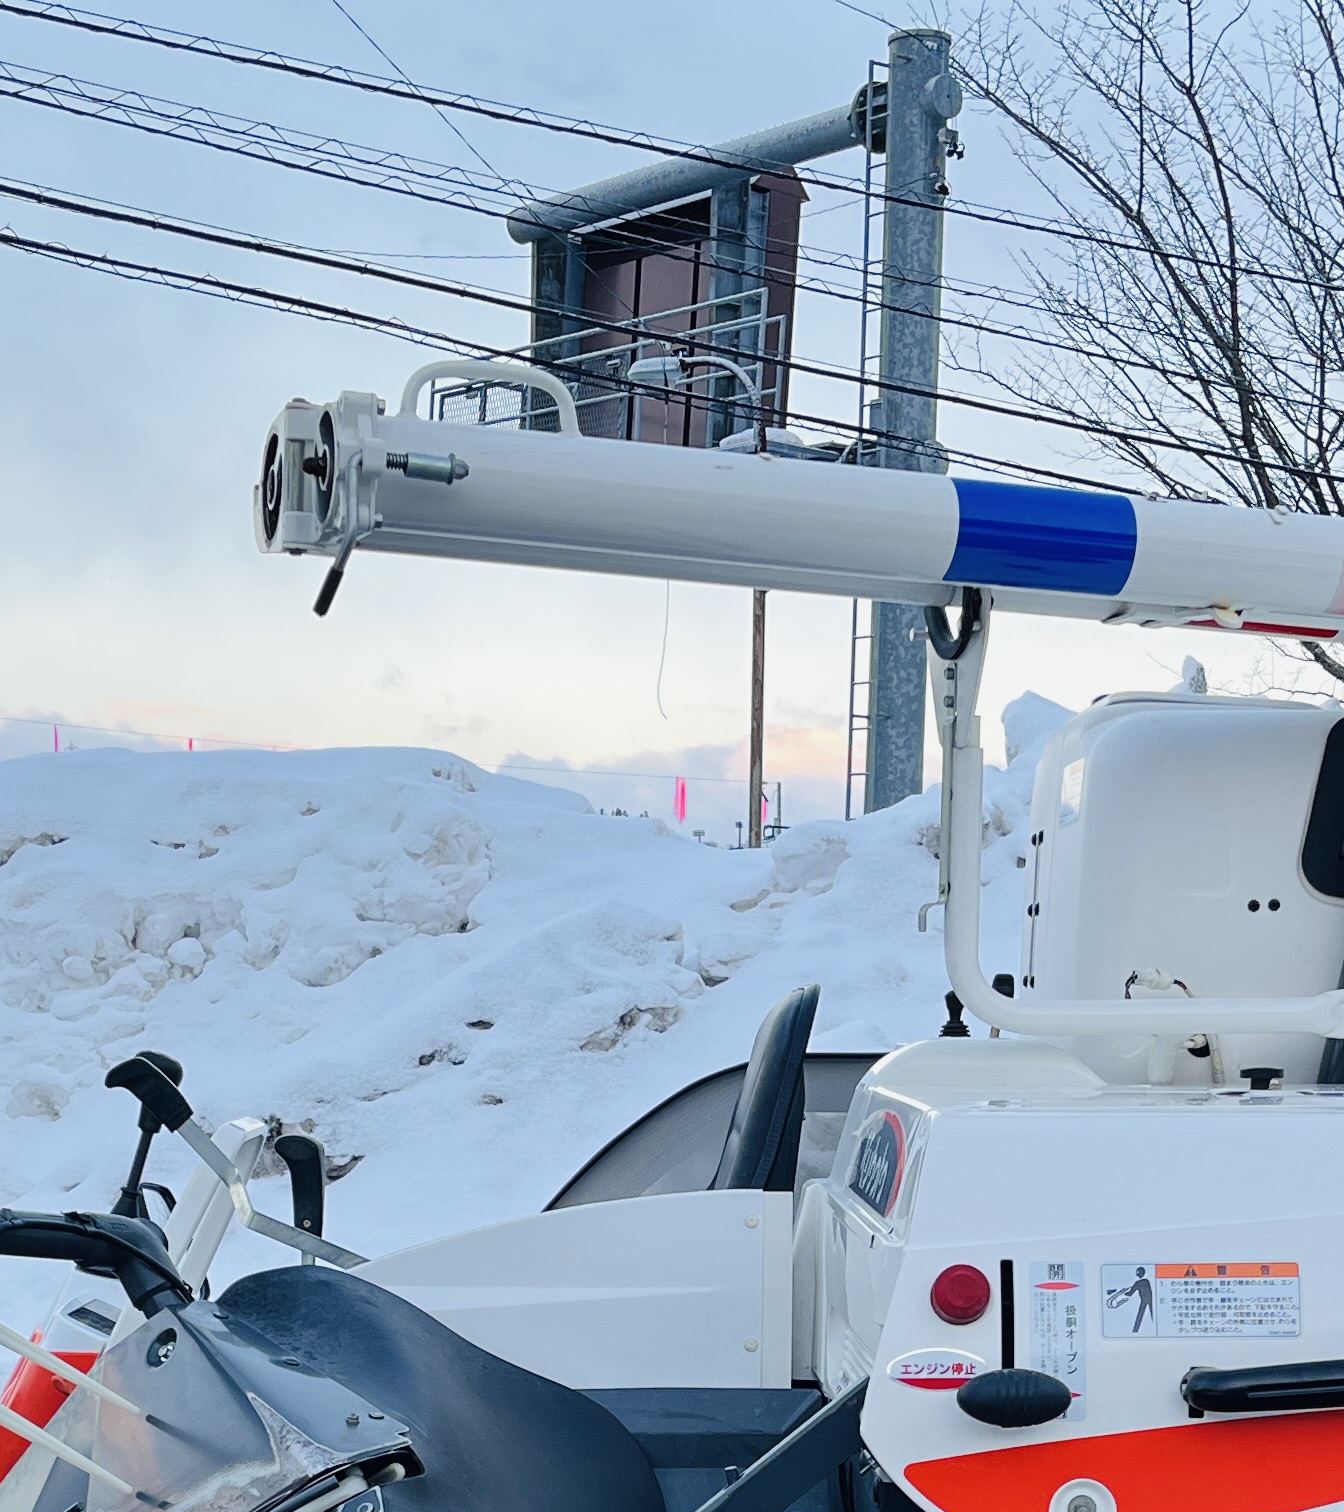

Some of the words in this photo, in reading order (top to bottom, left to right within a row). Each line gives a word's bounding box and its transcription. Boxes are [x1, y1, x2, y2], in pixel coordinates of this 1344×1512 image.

[1048, 1263, 1066, 1281] 開
[900, 1362, 976, 1375] エンジン停止
